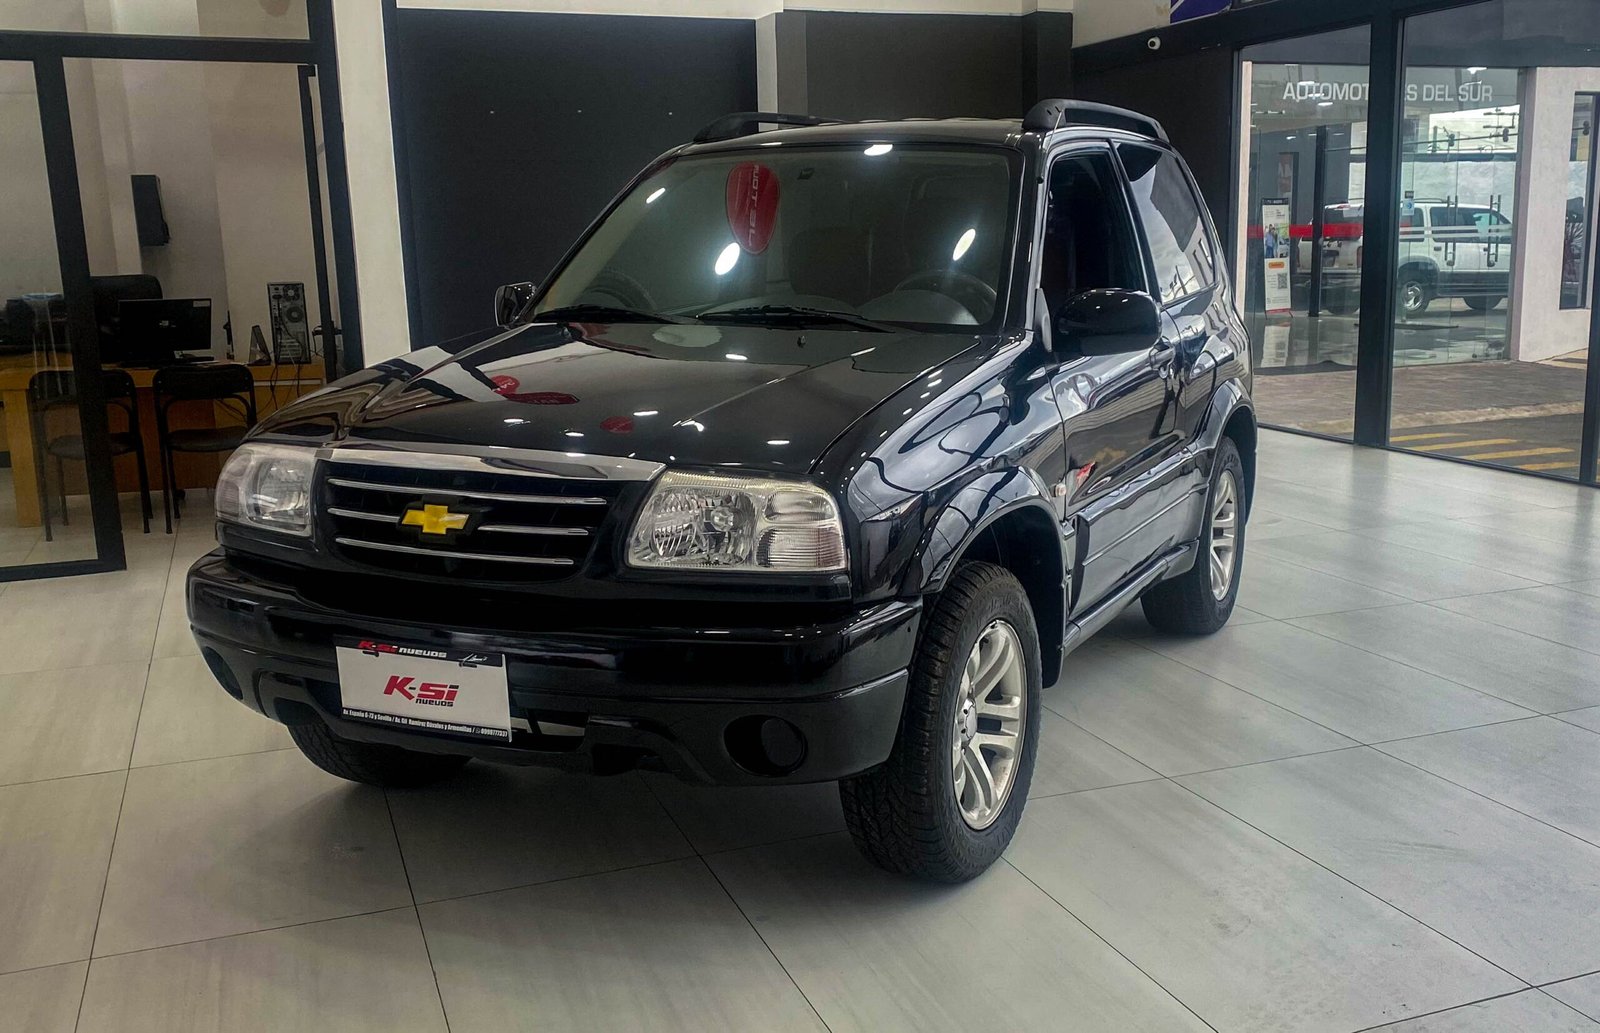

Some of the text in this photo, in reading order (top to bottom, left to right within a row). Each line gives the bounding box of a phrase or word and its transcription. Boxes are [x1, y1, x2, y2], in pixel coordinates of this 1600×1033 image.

[1282, 81, 1493, 102] AUTOMOTS DEL SUR
